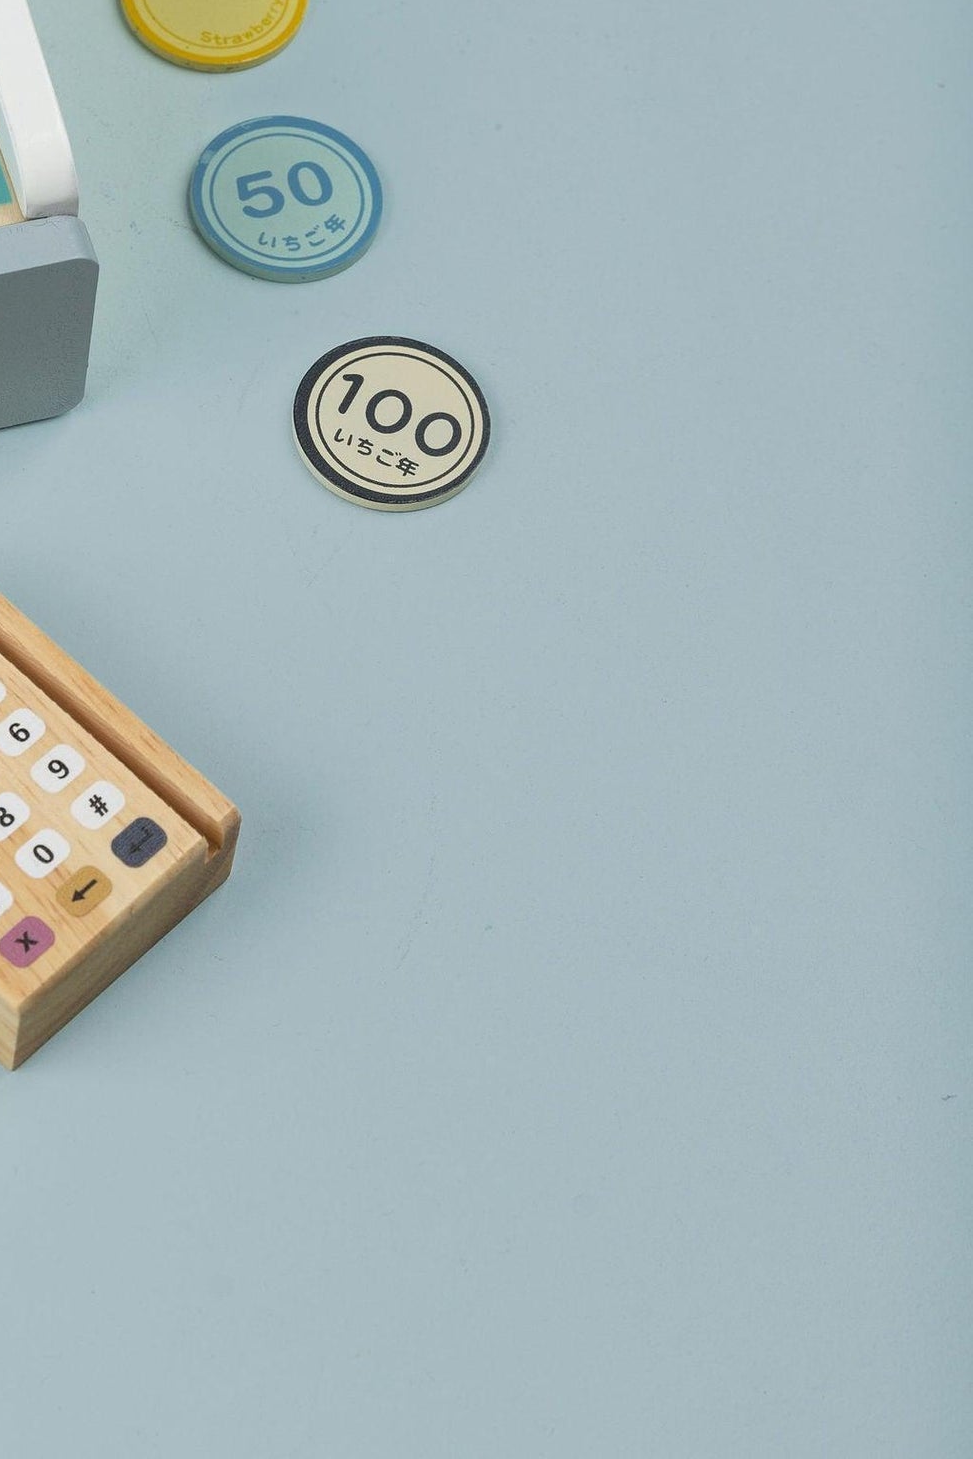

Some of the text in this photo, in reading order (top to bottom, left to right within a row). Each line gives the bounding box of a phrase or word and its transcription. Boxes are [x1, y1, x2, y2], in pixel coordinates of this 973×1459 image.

[235, 161, 334, 219] 50
[258, 213, 347, 252] いちご年
[337, 373, 462, 457] 100
[333, 428, 420, 477] いちご年
[8, 721, 31, 744] 6
[46, 758, 71, 780] 9
[32, 793, 110, 865] 0 #
